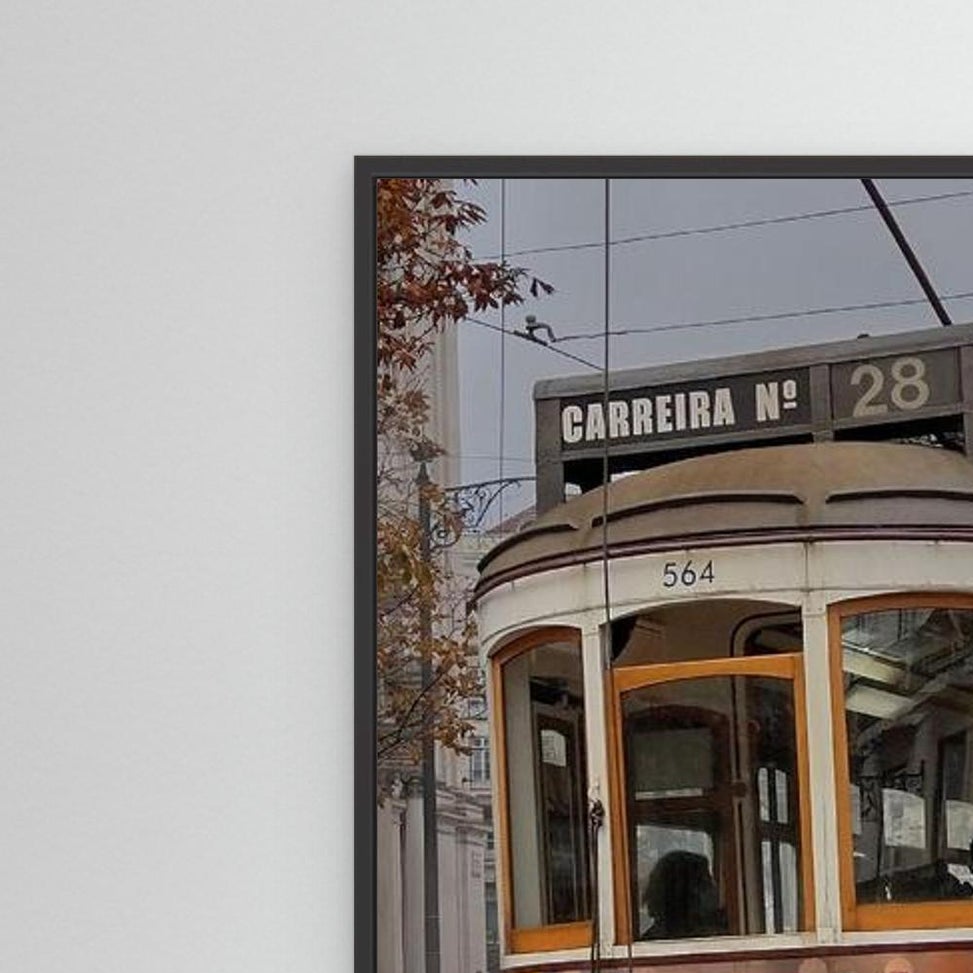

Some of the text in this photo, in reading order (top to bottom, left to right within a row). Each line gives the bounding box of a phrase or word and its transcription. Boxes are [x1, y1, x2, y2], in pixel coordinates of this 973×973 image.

[561, 357, 931, 443] CARREIRA Nº 28
[662, 560, 716, 588] 564
